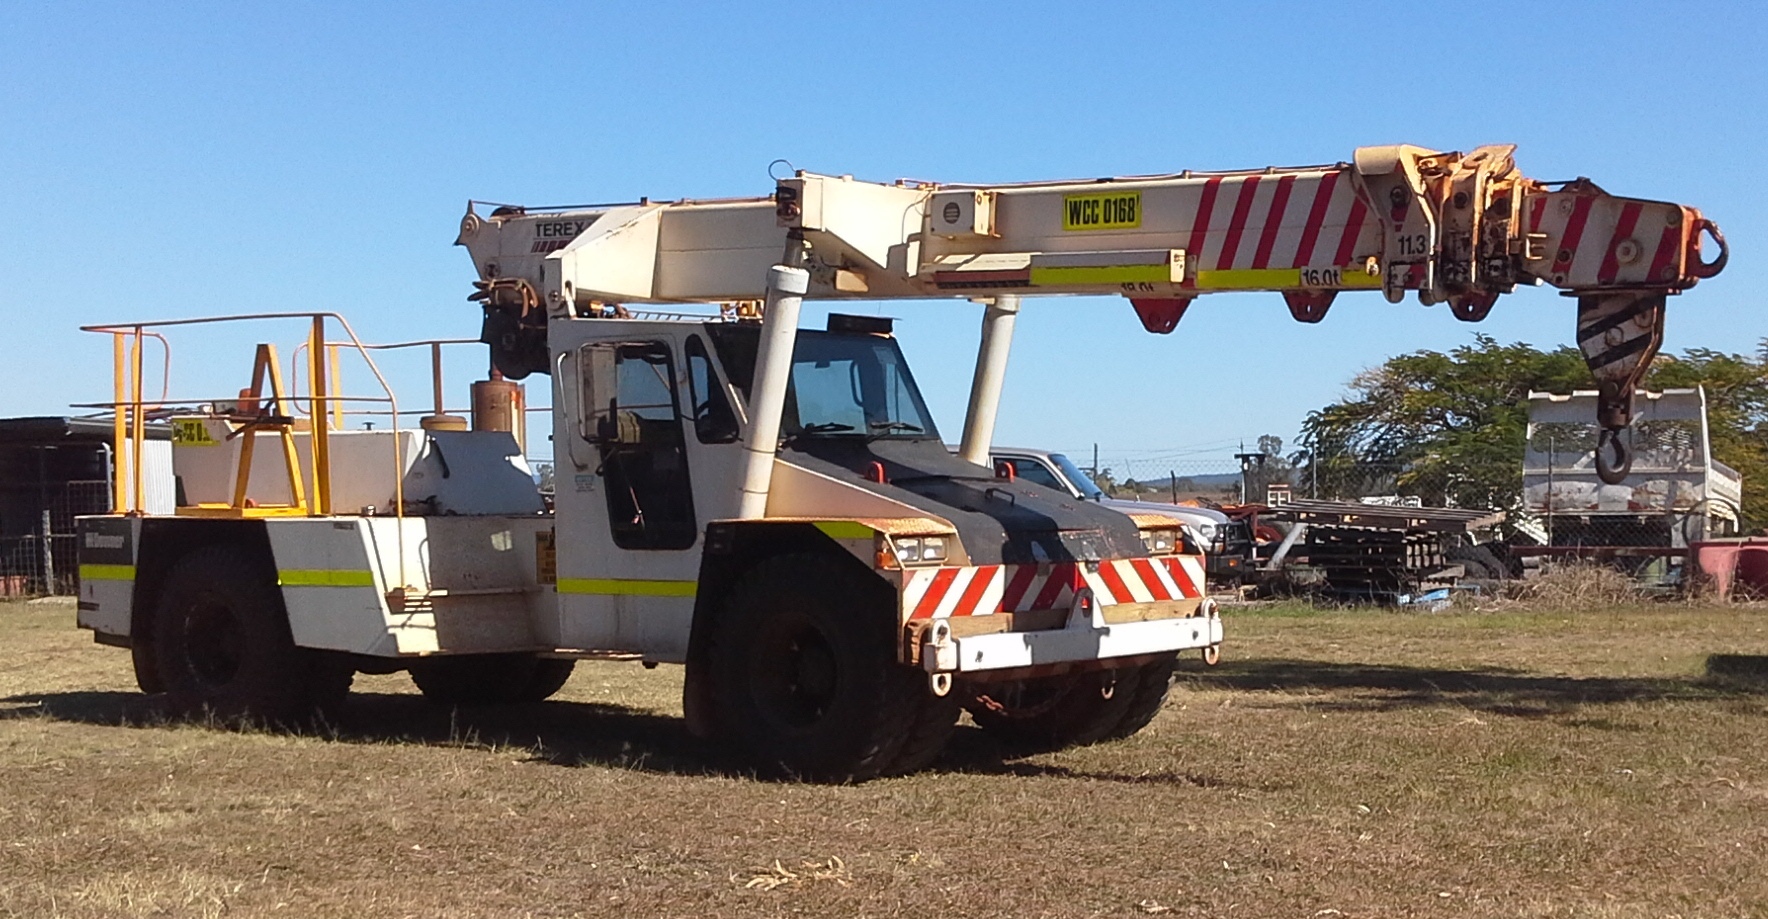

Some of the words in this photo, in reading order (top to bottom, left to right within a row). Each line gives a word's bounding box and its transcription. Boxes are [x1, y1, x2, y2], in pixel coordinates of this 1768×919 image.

[1069, 199, 1099, 226] WCC
[1103, 197, 1135, 224] 0168
[535, 222, 584, 237] TEREX
[1397, 234, 1427, 256] 11.3
[1302, 269, 1342, 286] 16.0t
